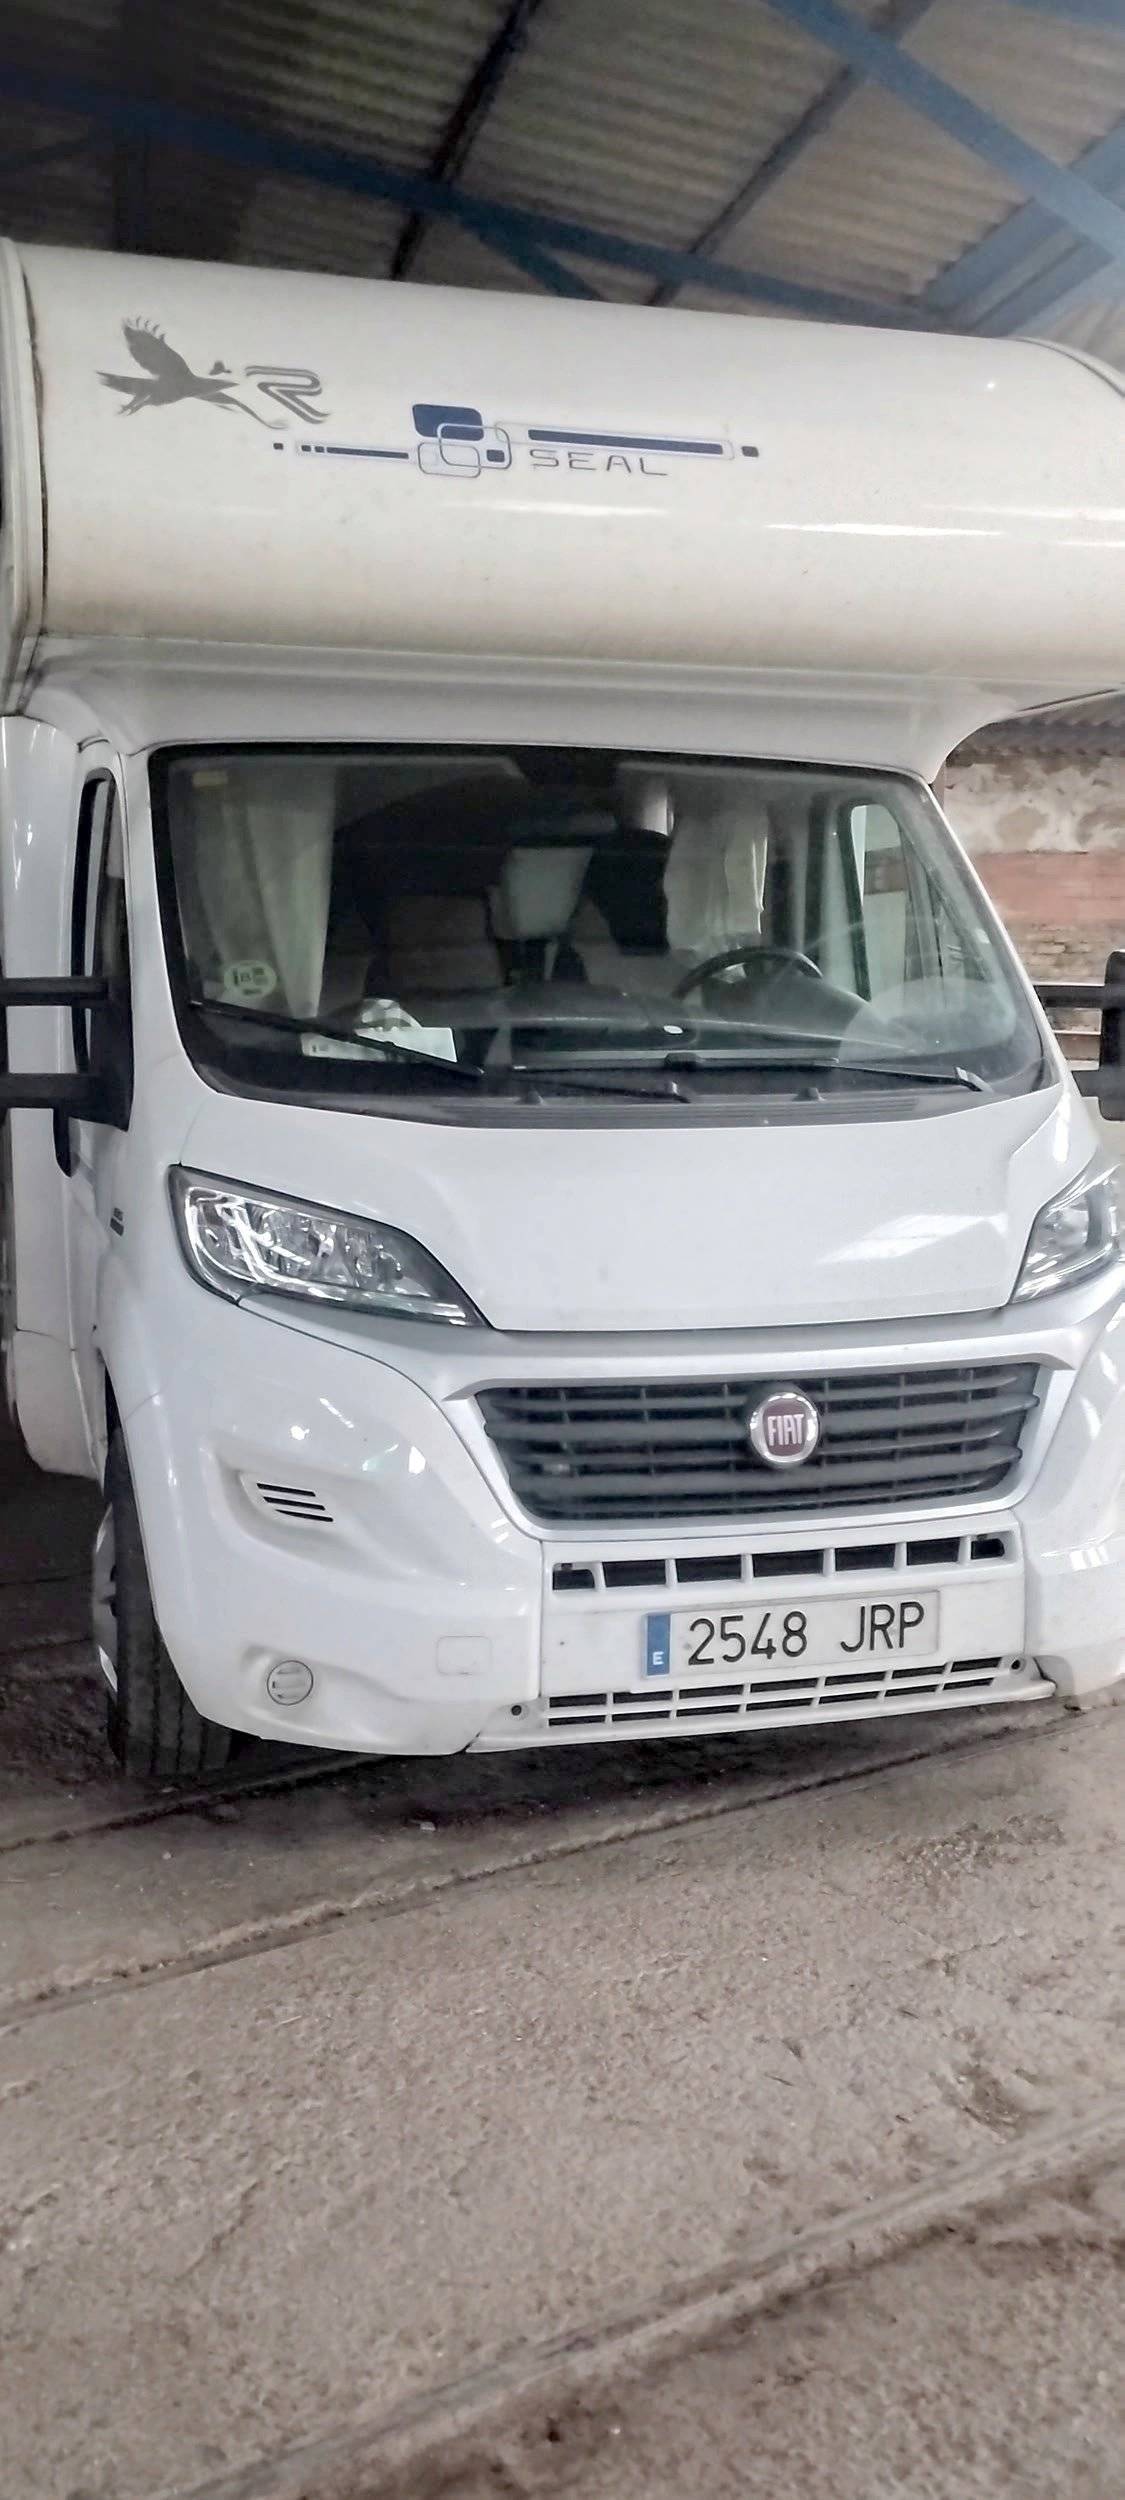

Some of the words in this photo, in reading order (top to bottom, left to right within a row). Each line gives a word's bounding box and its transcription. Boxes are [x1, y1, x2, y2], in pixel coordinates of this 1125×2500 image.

[529, 448, 669, 477] SEAL
[767, 1413, 805, 1447] FIAT
[688, 1611, 807, 1666] 2548
[840, 1601, 925, 1653] JRP
[652, 1651, 665, 1666] E
